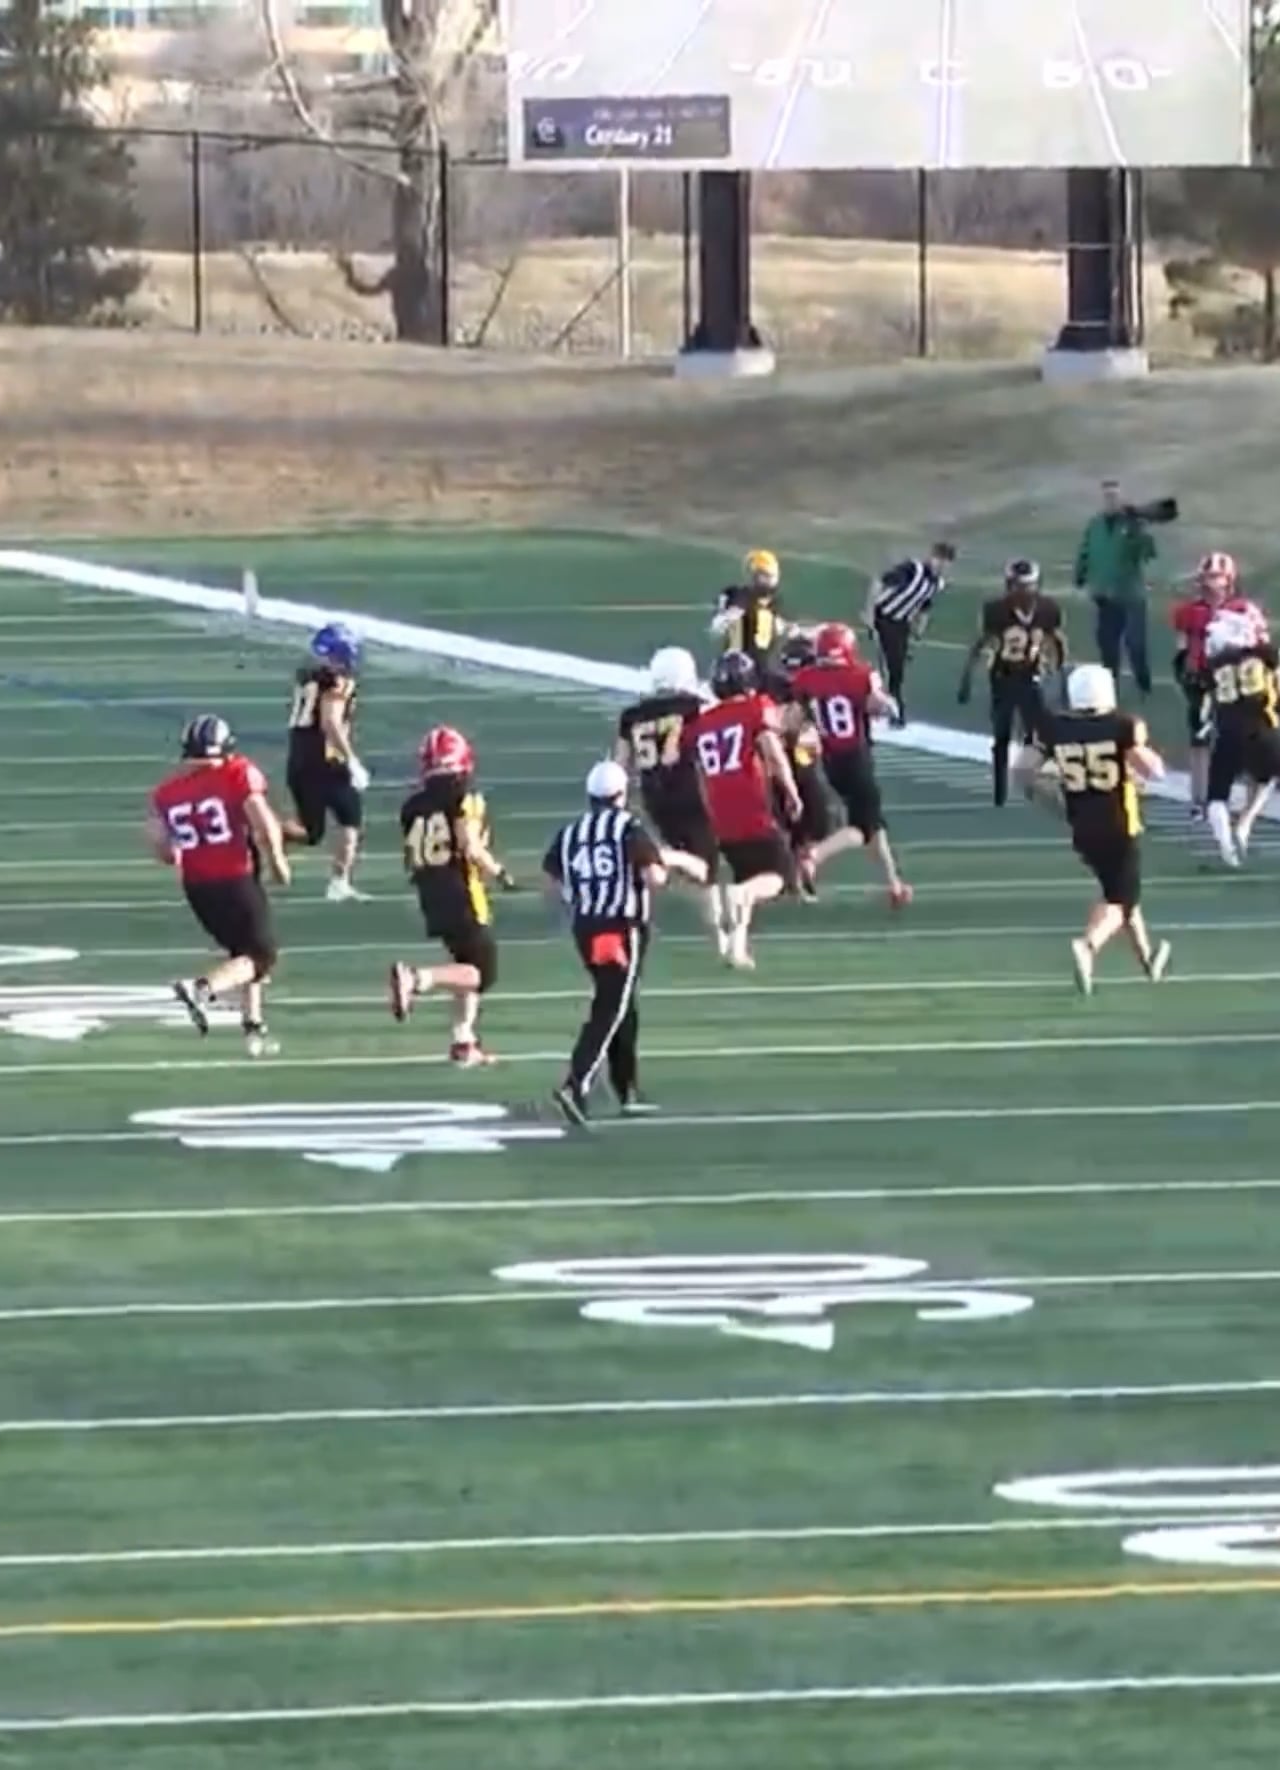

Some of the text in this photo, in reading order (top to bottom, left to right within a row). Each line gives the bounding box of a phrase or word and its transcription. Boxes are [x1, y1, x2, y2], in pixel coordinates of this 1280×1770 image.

[584, 123, 649, 150] Century
[631, 714, 683, 768] 57
[697, 723, 744, 775] 67
[1054, 740, 1119, 792] 55
[167, 796, 232, 850] 53
[571, 844, 615, 879] 46
